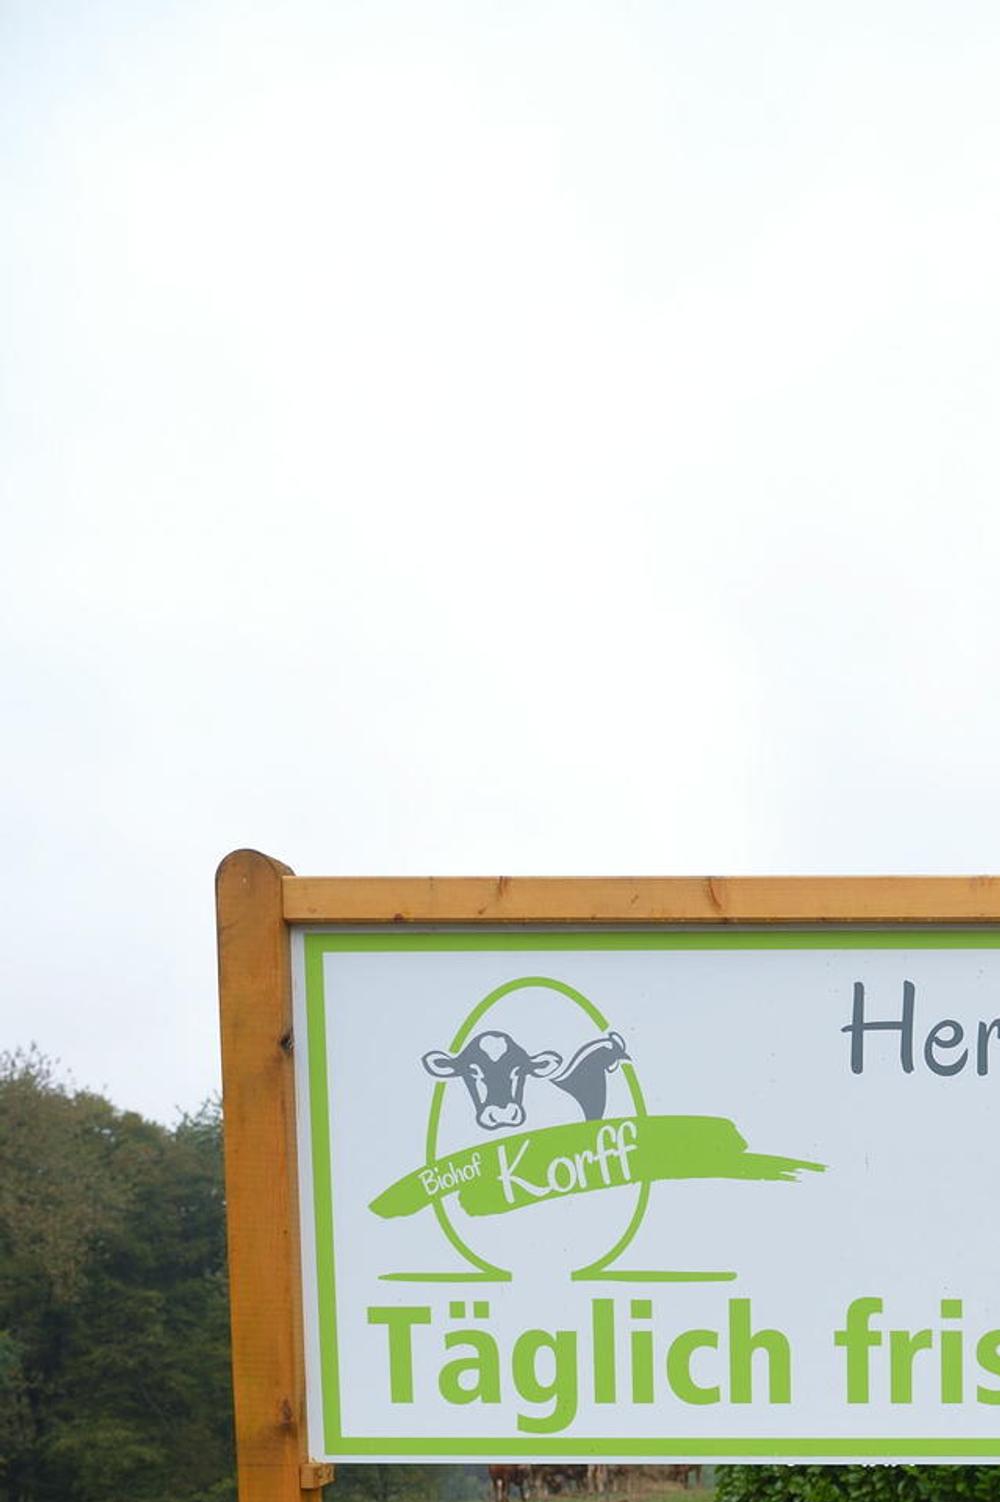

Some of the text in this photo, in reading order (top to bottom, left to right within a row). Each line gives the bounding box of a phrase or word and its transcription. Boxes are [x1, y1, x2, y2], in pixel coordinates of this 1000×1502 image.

[417, 1121, 637, 1204] Biohof Korff
[368, 1299, 790, 1433] Täglich
